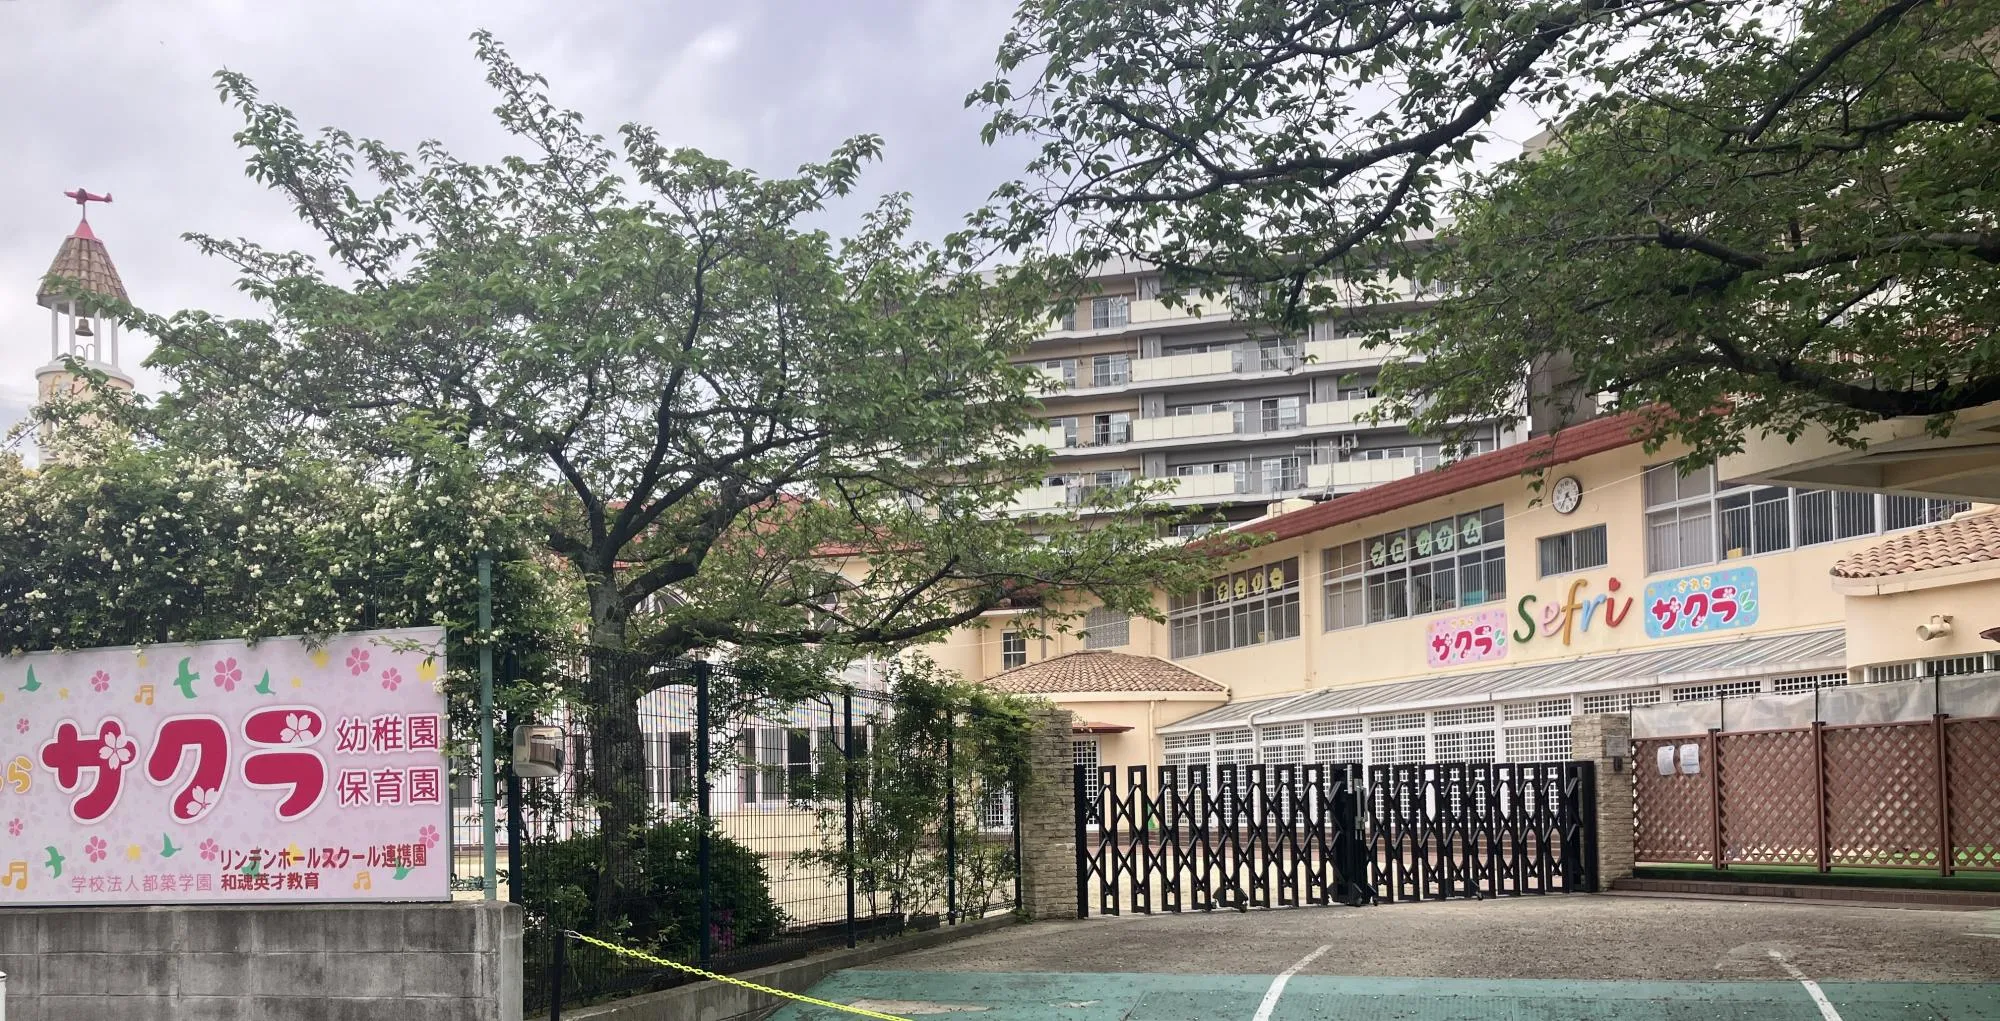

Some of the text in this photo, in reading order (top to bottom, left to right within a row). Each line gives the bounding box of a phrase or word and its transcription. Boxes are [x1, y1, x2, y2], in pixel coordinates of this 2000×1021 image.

[1513, 577, 1634, 646] Sefri
[1650, 585, 1738, 632] サクラ
[1431, 624, 1493, 662] サクラ
[336, 713, 440, 753] 幼稚園
[40, 706, 327, 822] サクラ
[337, 768, 441, 806] 保育園
[71, 874, 213, 894] 学校法人都築学園
[220, 872, 320, 892] 和魂英才教育
